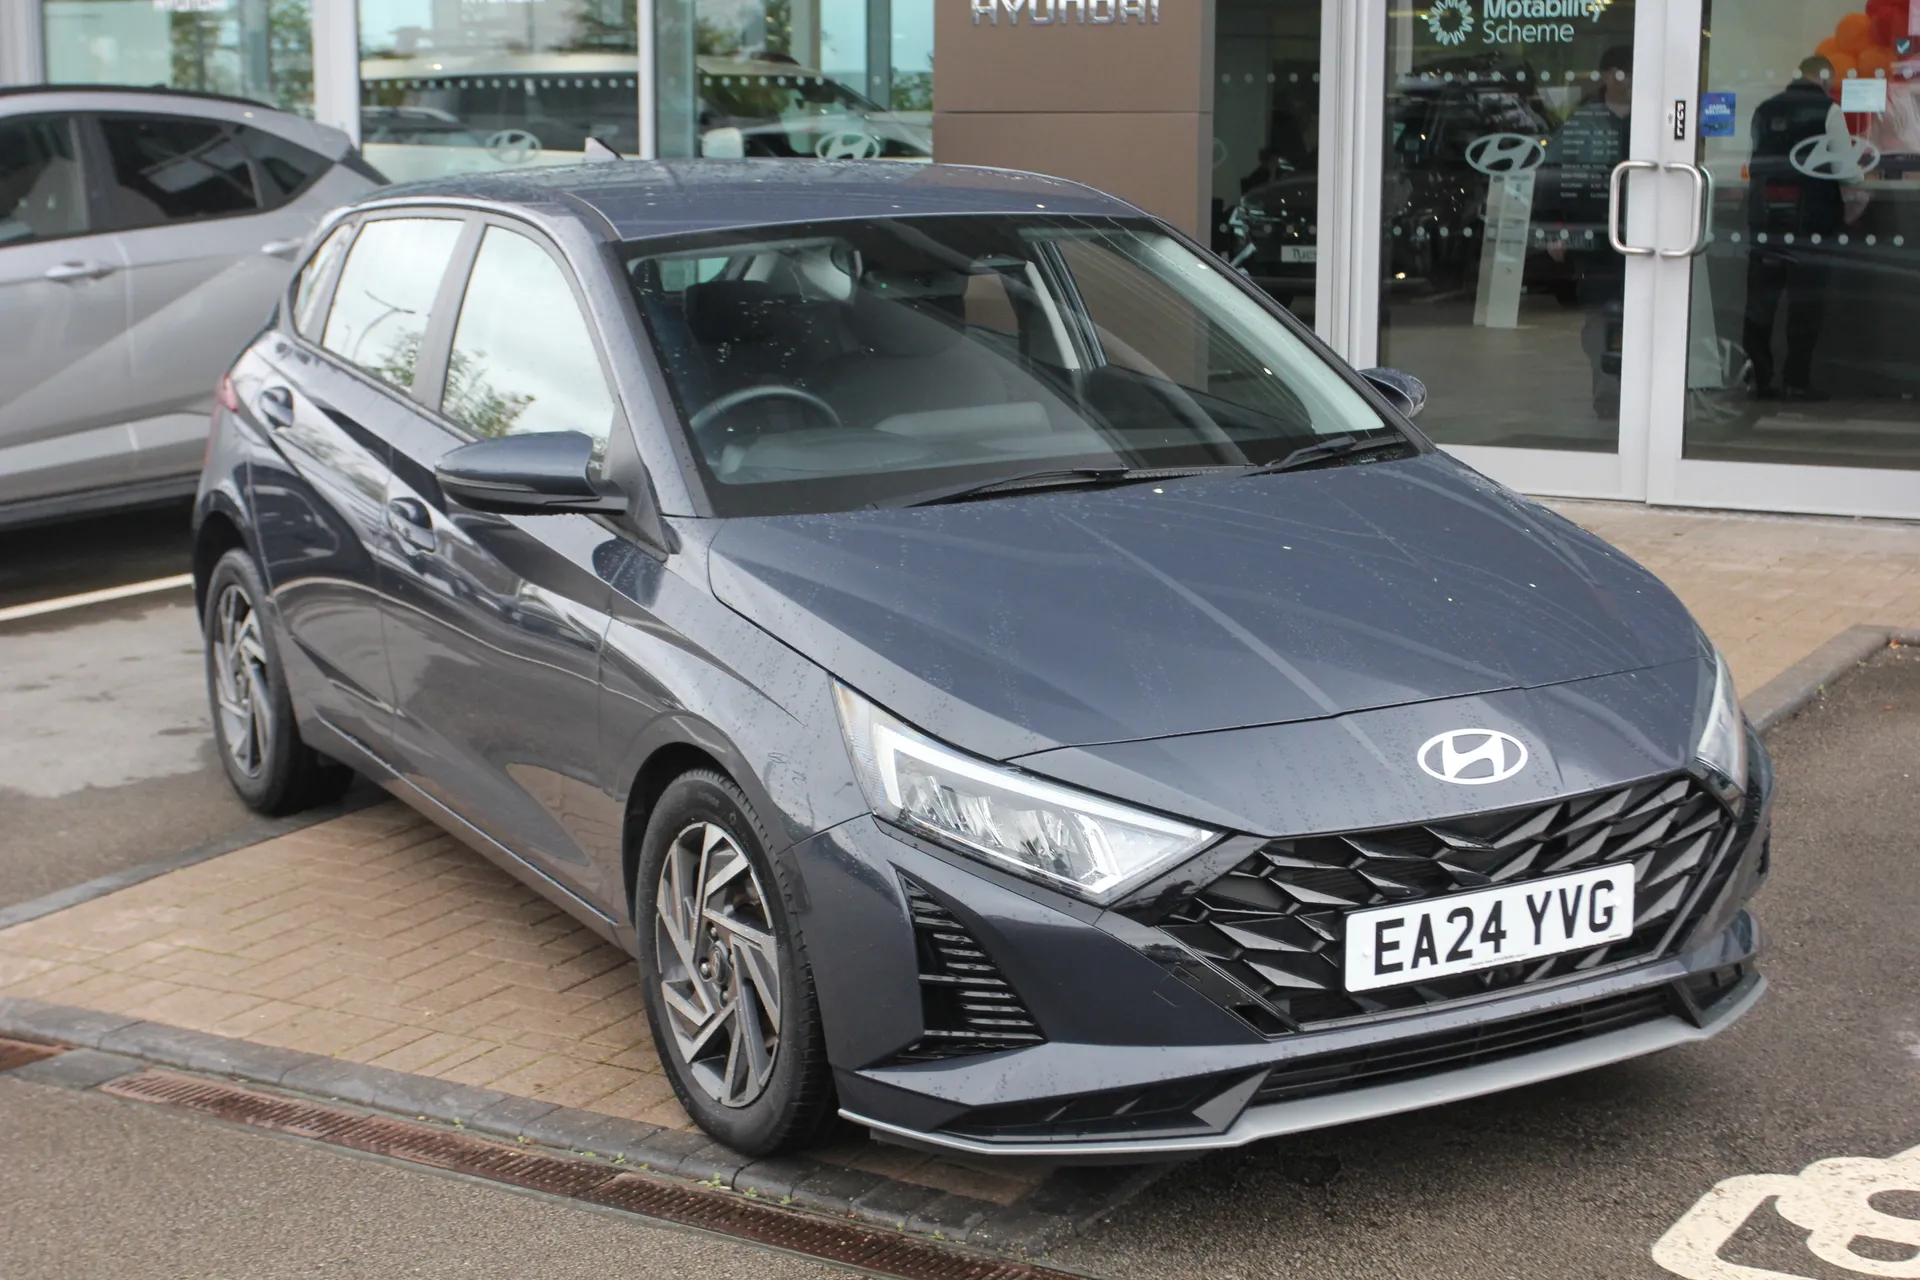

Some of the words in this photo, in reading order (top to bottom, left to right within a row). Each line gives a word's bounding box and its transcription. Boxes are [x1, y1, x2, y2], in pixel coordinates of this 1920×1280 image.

[971, 0, 1160, 26] HYUNDAI
[1483, 0, 1601, 22] Motability
[1482, 20, 1575, 44] Scheme
[1676, 102, 1684, 136] PULL
[1374, 900, 1507, 976] EA24
[1526, 879, 1615, 946] YVG
